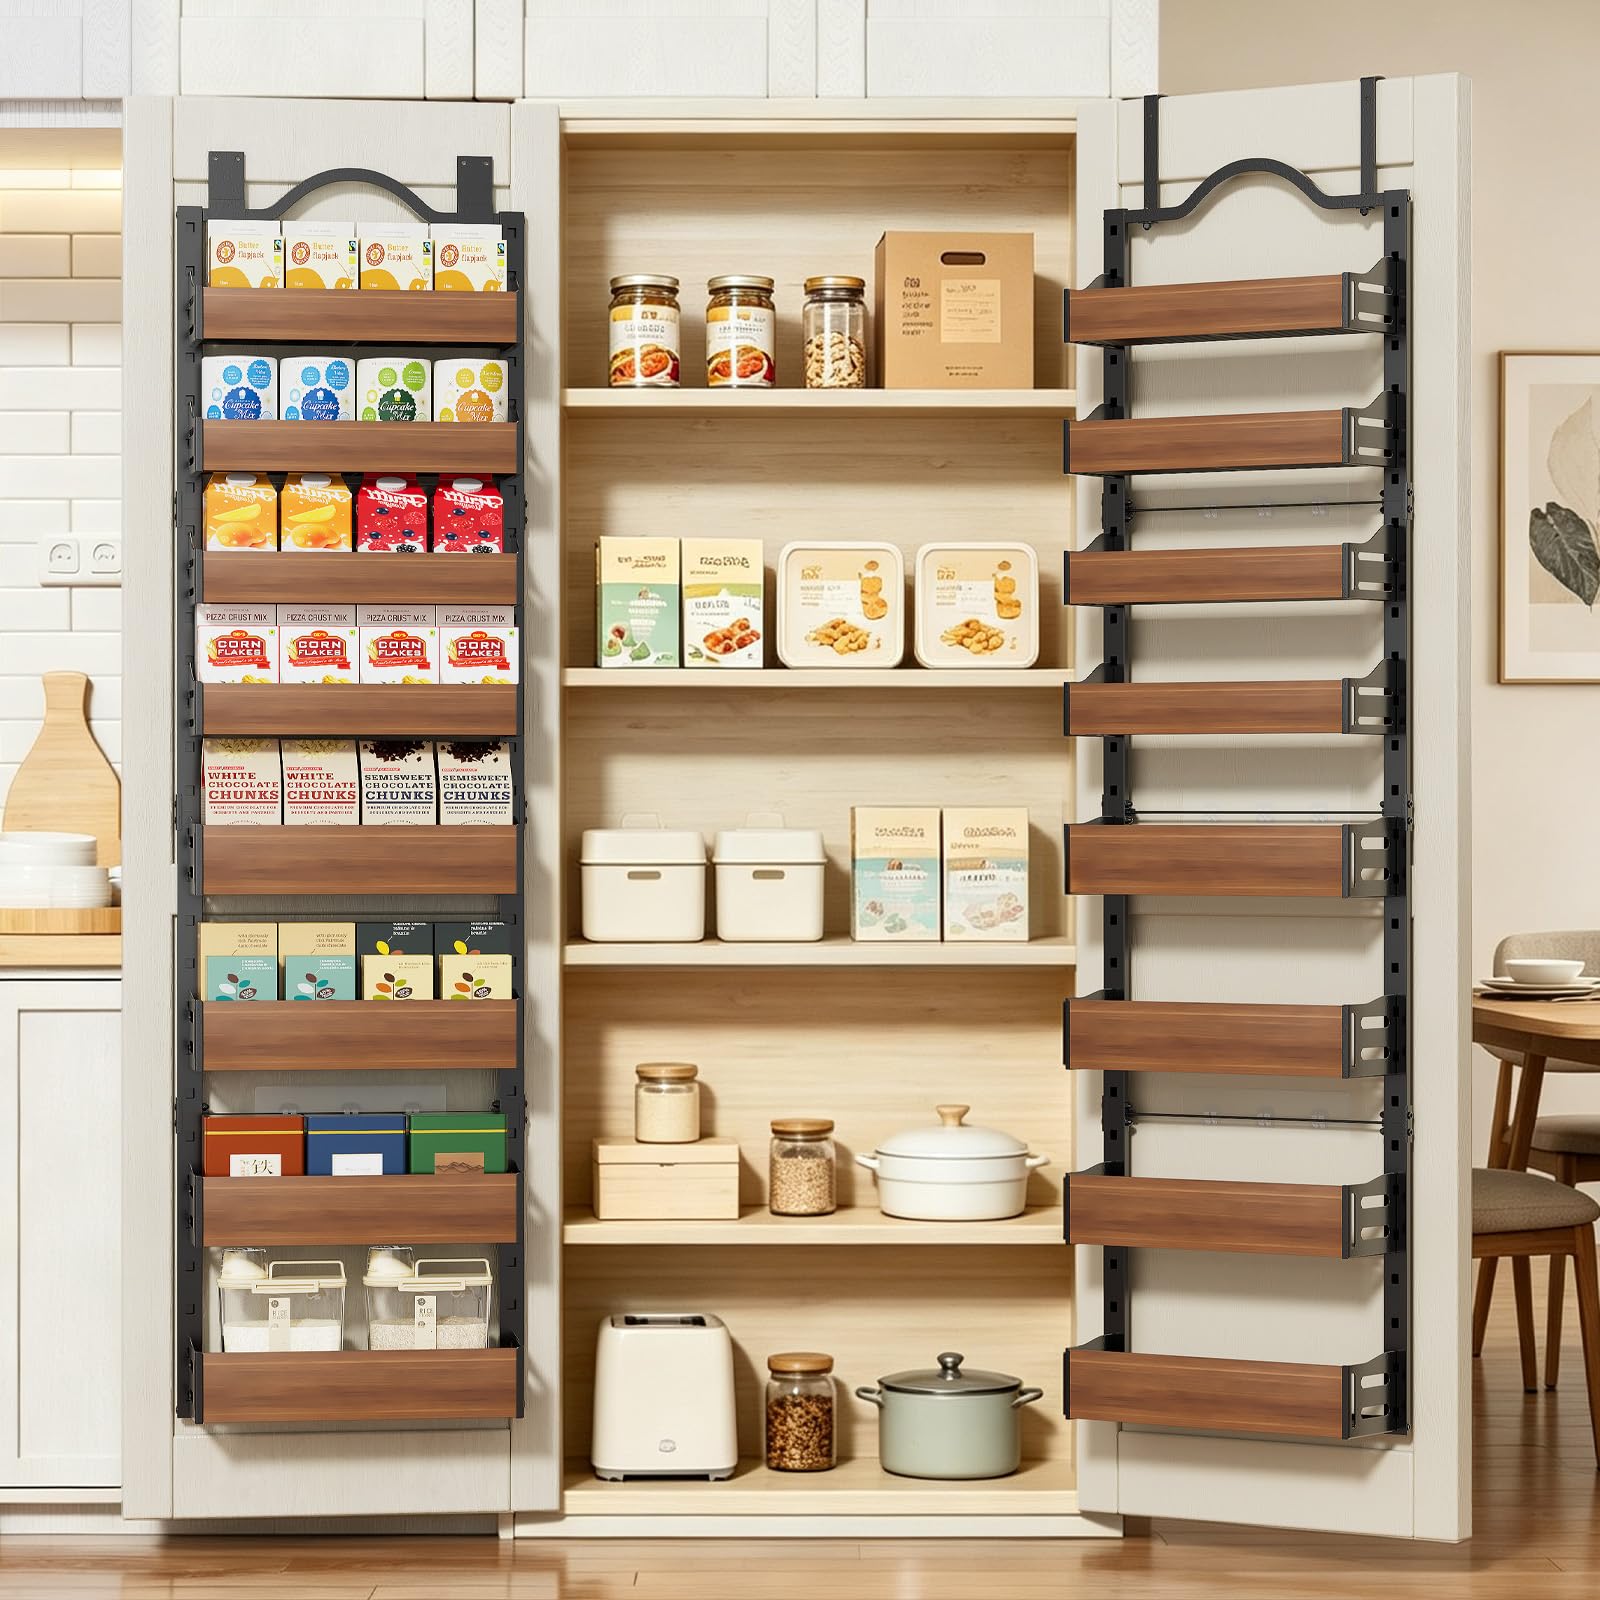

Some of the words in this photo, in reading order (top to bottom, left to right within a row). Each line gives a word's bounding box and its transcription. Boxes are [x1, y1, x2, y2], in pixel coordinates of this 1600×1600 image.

[225, 399, 260, 410] Cupcake
[303, 400, 337, 410] Cupcake
[380, 401, 415, 412] Cupcake
[458, 402, 492, 412] Cupcake
[234, 409, 256, 420] Mix
[312, 410, 334, 420] Mix
[390, 411, 412, 421] Mix
[468, 412, 489, 422] Mix
[206, 613, 226, 621] PIZZA
[228, 613, 252, 621] CRUST
[254, 613, 267, 621] MIX
[287, 614, 306, 622] PIZZA
[308, 614, 332, 622] CRUST
[334, 614, 348, 622] MIX
[367, 614, 386, 622] PIZZA
[388, 614, 412, 622] CRUST
[414, 614, 427, 622] MIX
[218, 640, 261, 649] CORN
[298, 641, 341, 649] CORN
[378, 641, 422, 649] CORN
[458, 641, 501, 649] CORN
[208, 772, 256, 780] WHITE
[287, 772, 334, 780] WHITE
[208, 790, 279, 800] CHUNKS
[287, 790, 356, 800] CHUNKS
[366, 791, 434, 800] CHUNKS
[444, 791, 511, 800] CHUNKS
